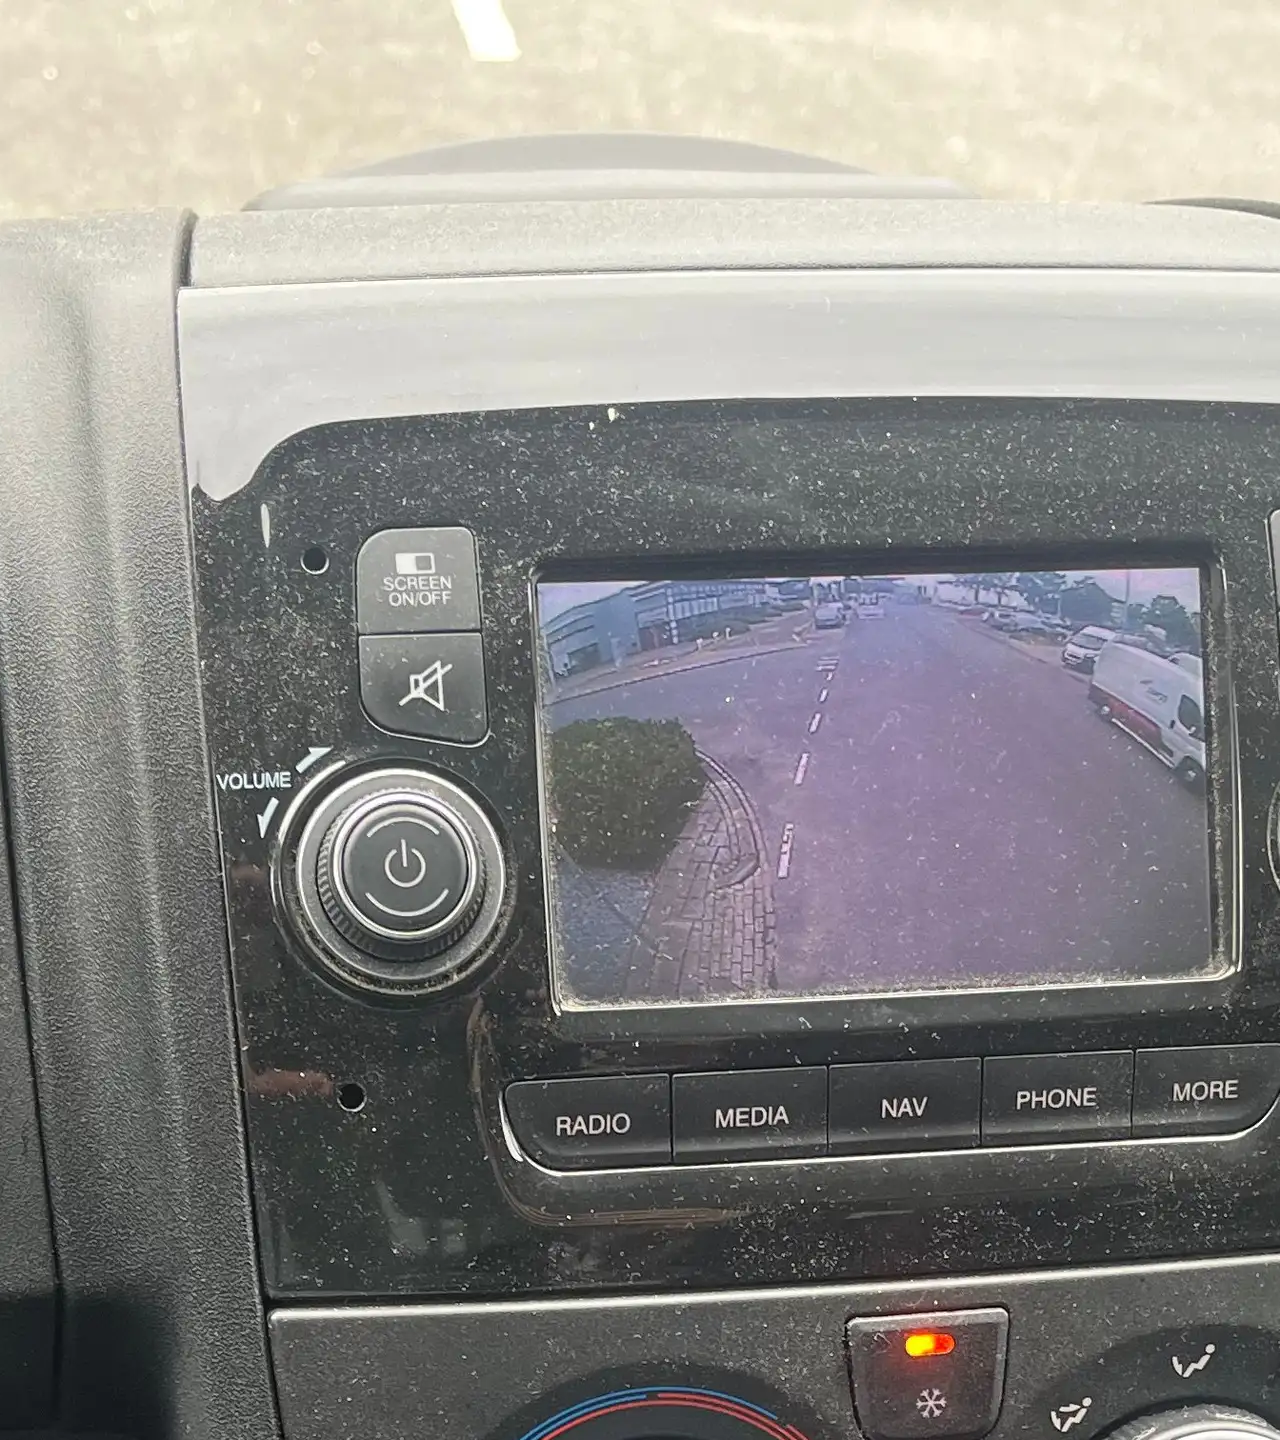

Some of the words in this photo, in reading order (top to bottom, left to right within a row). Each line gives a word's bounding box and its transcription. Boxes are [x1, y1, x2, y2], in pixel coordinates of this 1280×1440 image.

[383, 576, 452, 591] SCREEN
[388, 590, 452, 607] ON/OFF
[216, 771, 292, 790] VOLUME
[1015, 1087, 1098, 1110] PHONE
[1173, 1079, 1240, 1101] MORE
[715, 1106, 790, 1128] MEDIA
[880, 1096, 928, 1119] NAV
[555, 1112, 631, 1136] RADIO
